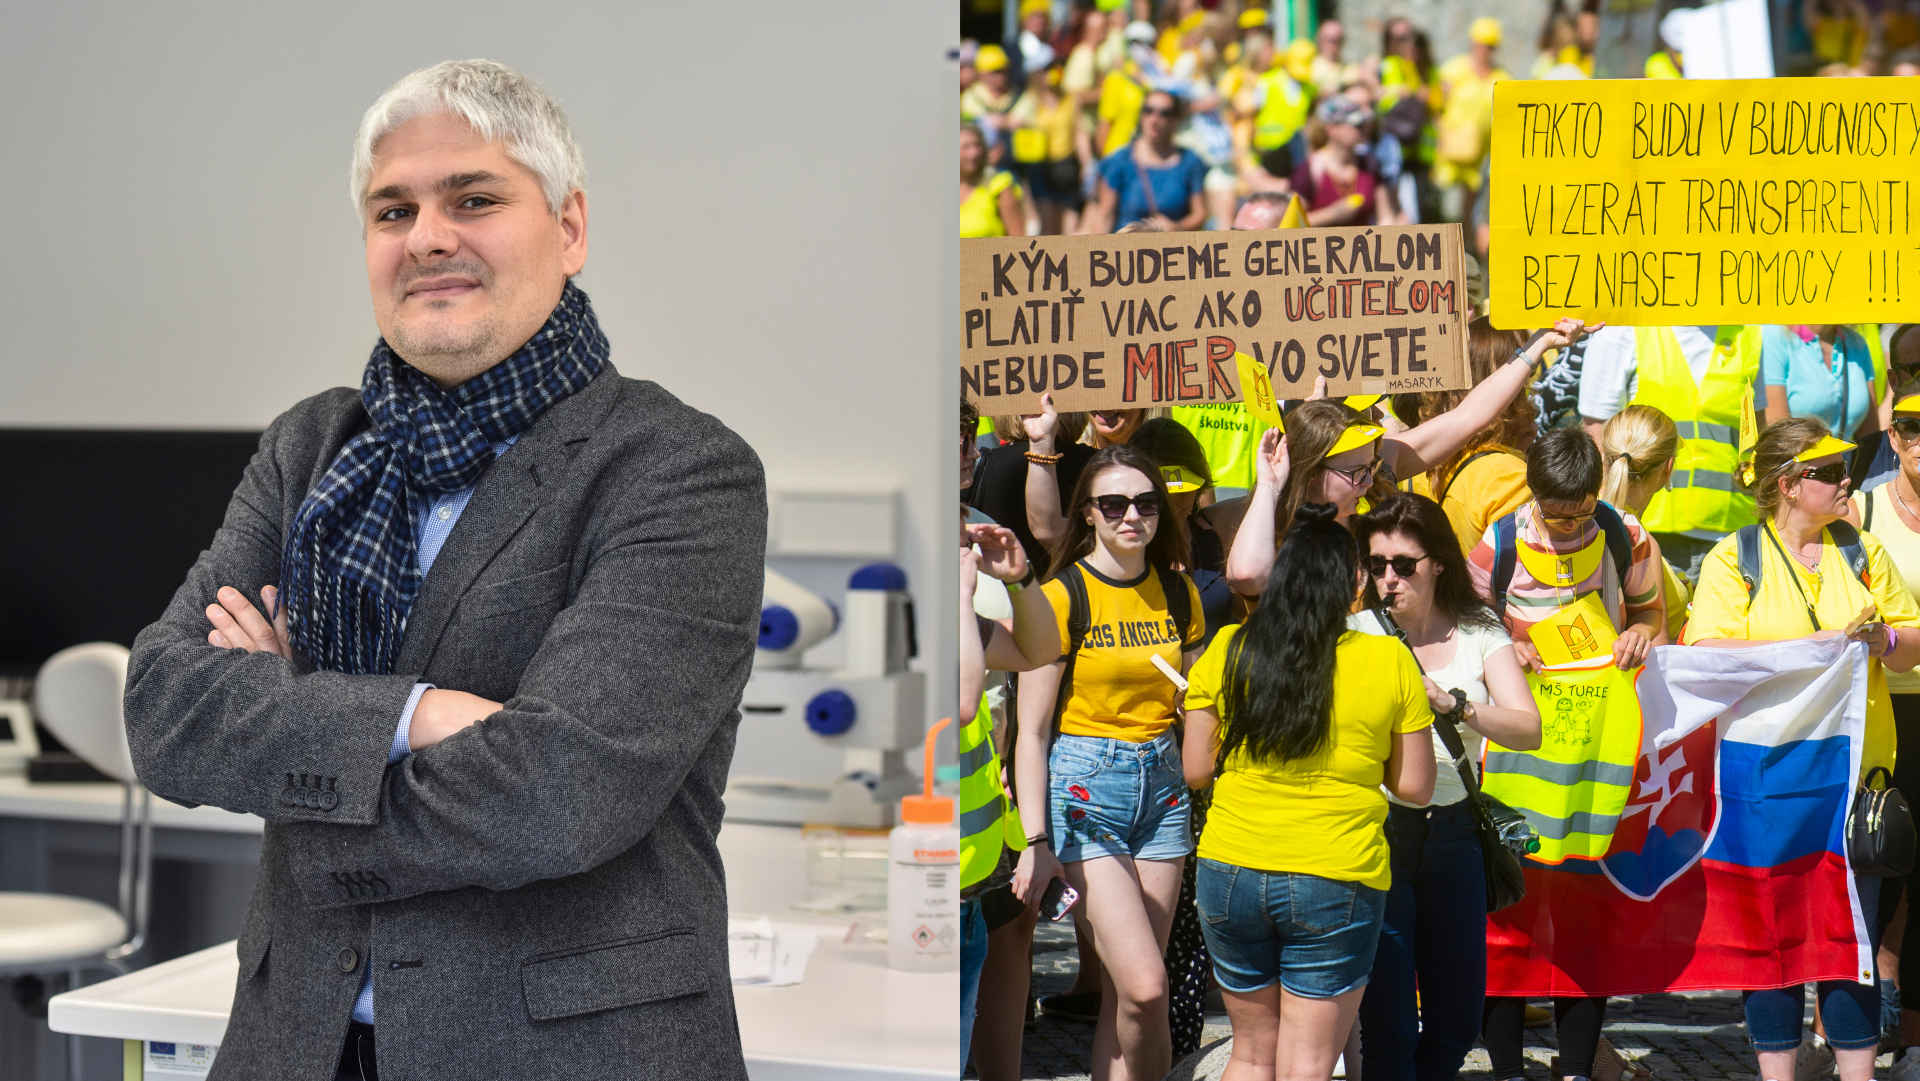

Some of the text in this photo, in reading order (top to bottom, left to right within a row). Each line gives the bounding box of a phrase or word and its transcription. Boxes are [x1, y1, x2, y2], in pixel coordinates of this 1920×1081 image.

[1517, 101, 1603, 158] TAKTO
[1632, 101, 1705, 159] BUDU
[1719, 101, 1739, 154] V
[1680, 178, 1910, 235] TRANSPARENTI
[1090, 242, 1231, 288] BUDEME
[1244, 228, 1442, 277] GENERÁLOM
[1524, 249, 1901, 310] BEZ NASEJ POMOCY !!!
[965, 288, 1085, 349] PLATIŤ
[1101, 294, 1178, 338] VIAC
[1194, 289, 1262, 329] AKO
[960, 351, 1106, 398] NEBUDE
[1122, 335, 1237, 403] MIER
[1252, 338, 1306, 384] VO
[1389, 376, 1445, 390] MASARYK
[1199, 415, 1249, 432] školstva
[1118, 618, 1180, 648] ANGELE
[1540, 681, 1610, 699] MŠ TURIE
